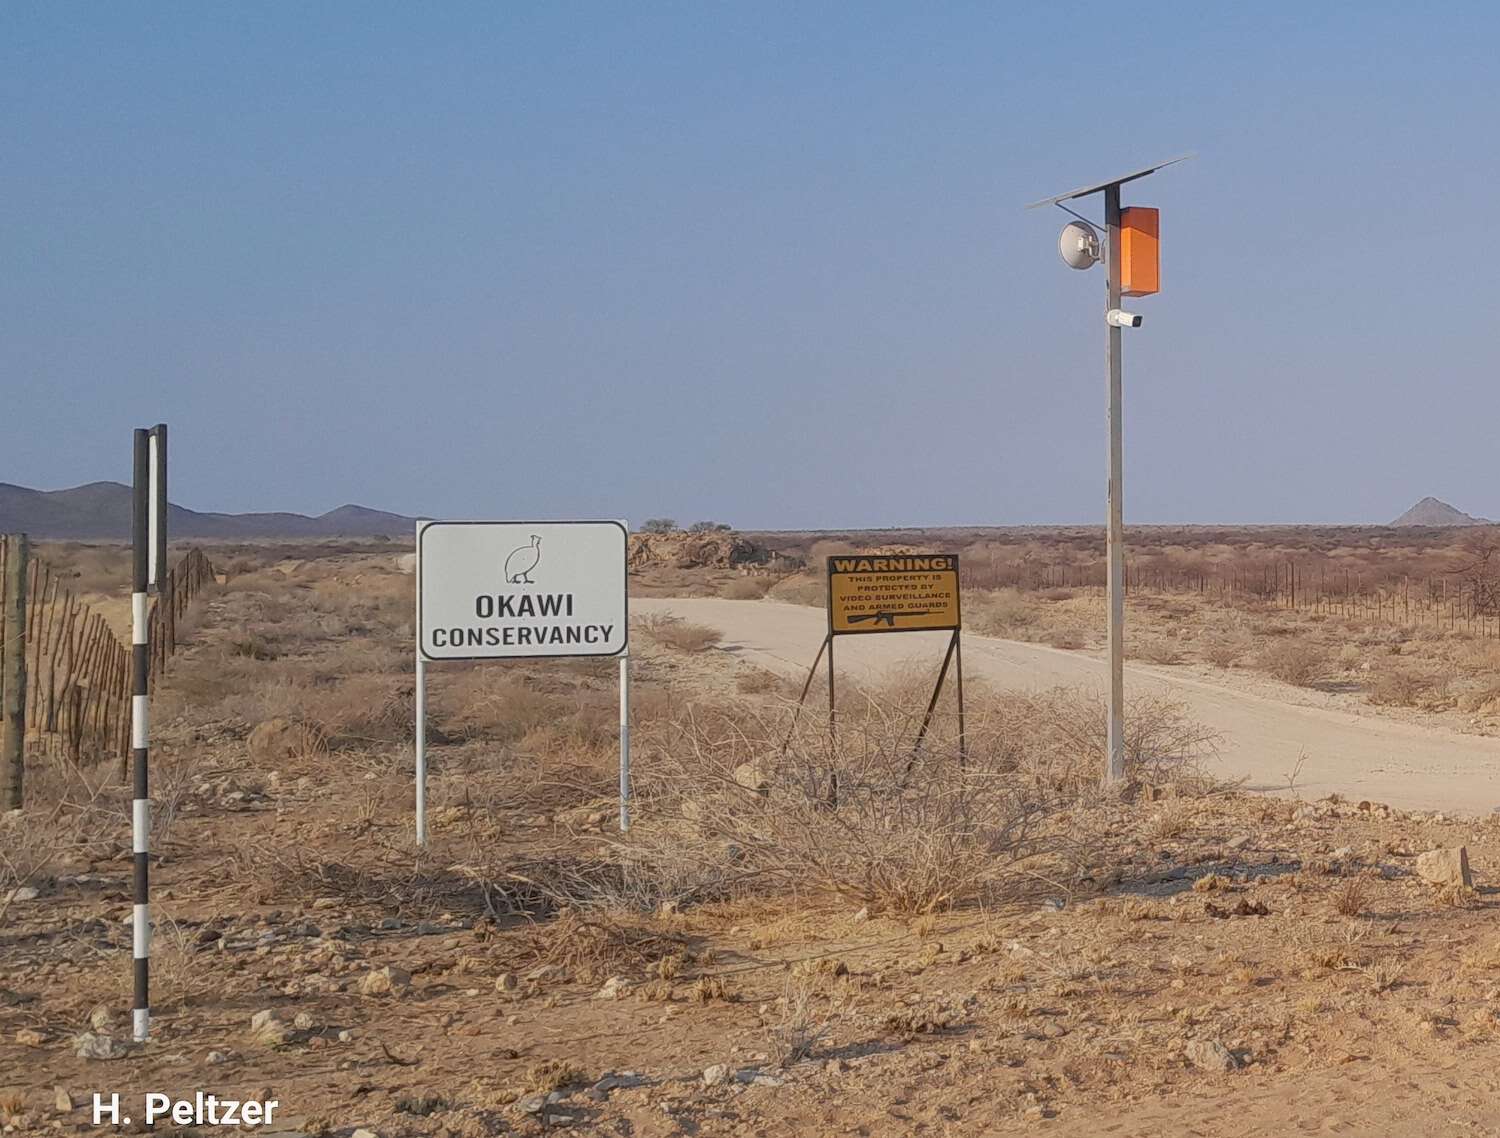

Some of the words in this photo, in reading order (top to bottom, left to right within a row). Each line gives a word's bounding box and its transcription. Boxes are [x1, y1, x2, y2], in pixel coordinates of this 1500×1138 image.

[834, 557, 953, 572] WARNING!
[876, 574, 930, 582] PROPERTY
[857, 584, 918, 592] PROTECTED
[839, 594, 872, 602] VIDEO
[875, 592, 951, 601] SURVEILLANCE
[475, 593, 573, 618] OKAWI
[907, 601, 949, 609] GUARDS
[432, 624, 614, 647] CONSERVANCY
